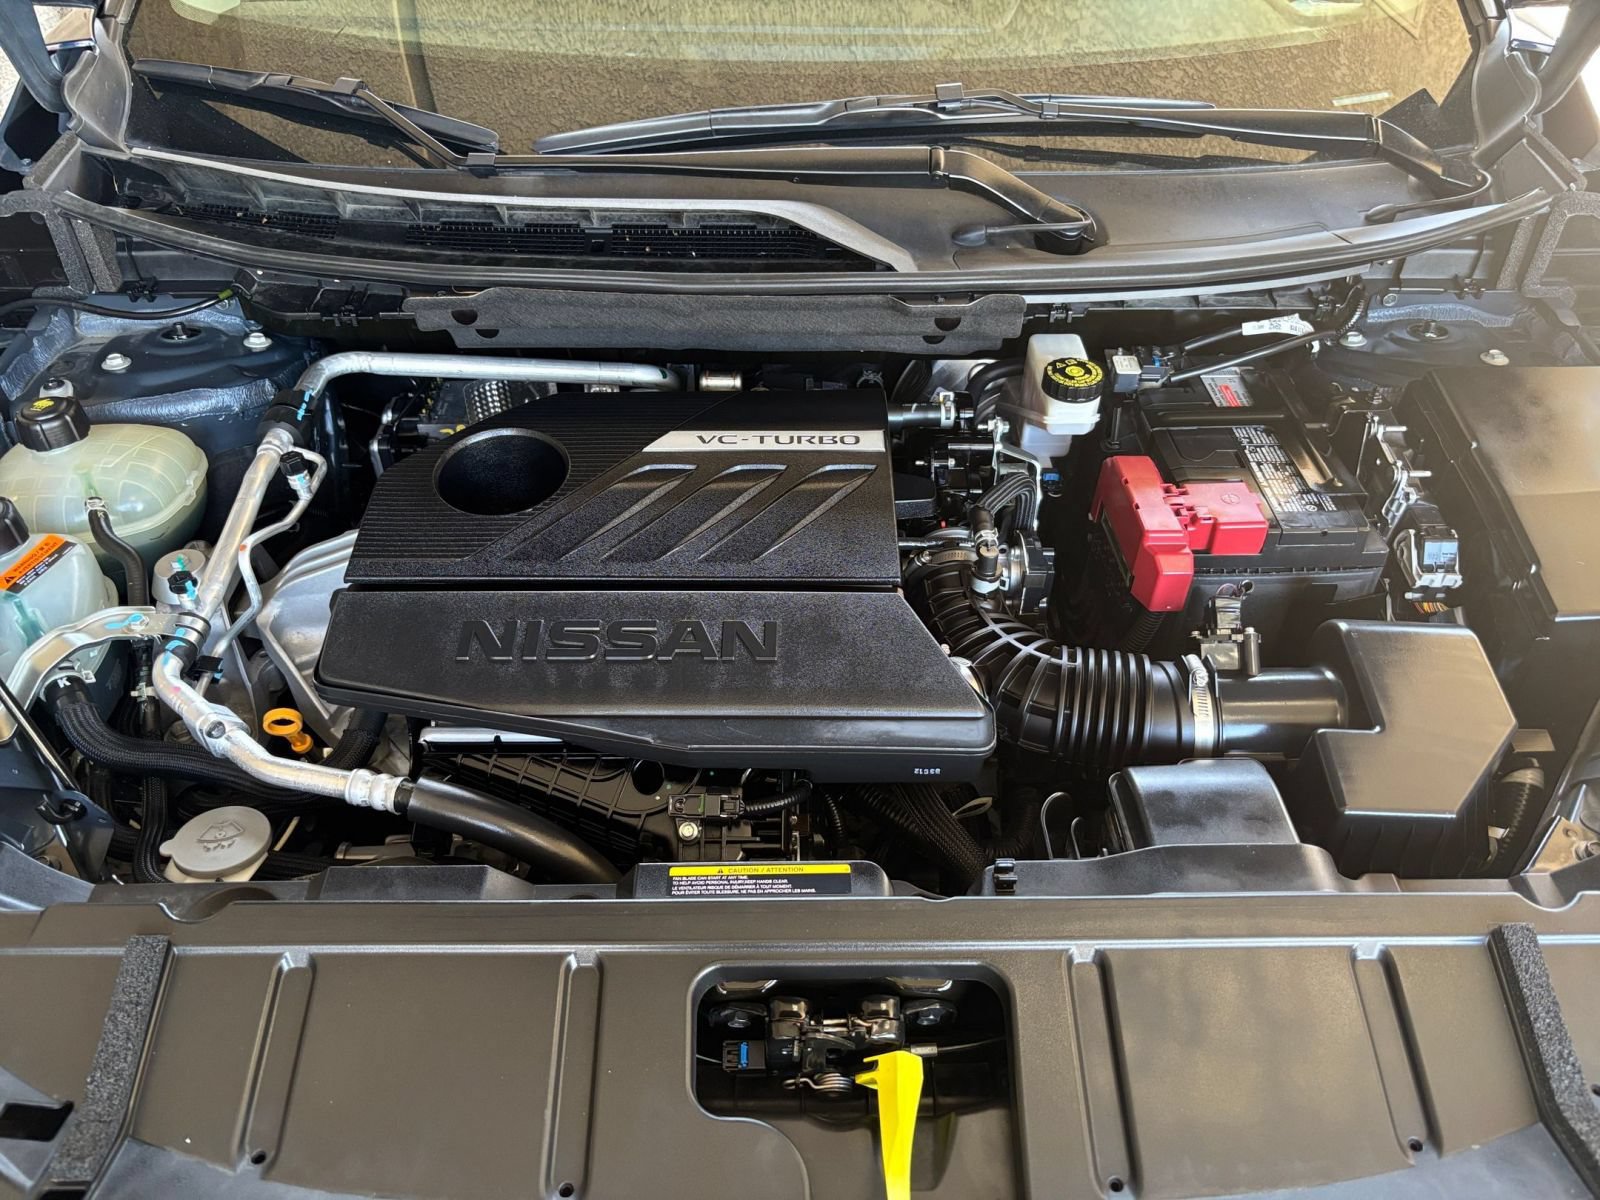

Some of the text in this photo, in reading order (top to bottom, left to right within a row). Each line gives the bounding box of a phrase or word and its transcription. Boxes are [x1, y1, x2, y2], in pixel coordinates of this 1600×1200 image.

[696, 435, 860, 445] VC-TURBO
[455, 619, 777, 660] NISSAN
[57, 677, 71, 688] K
